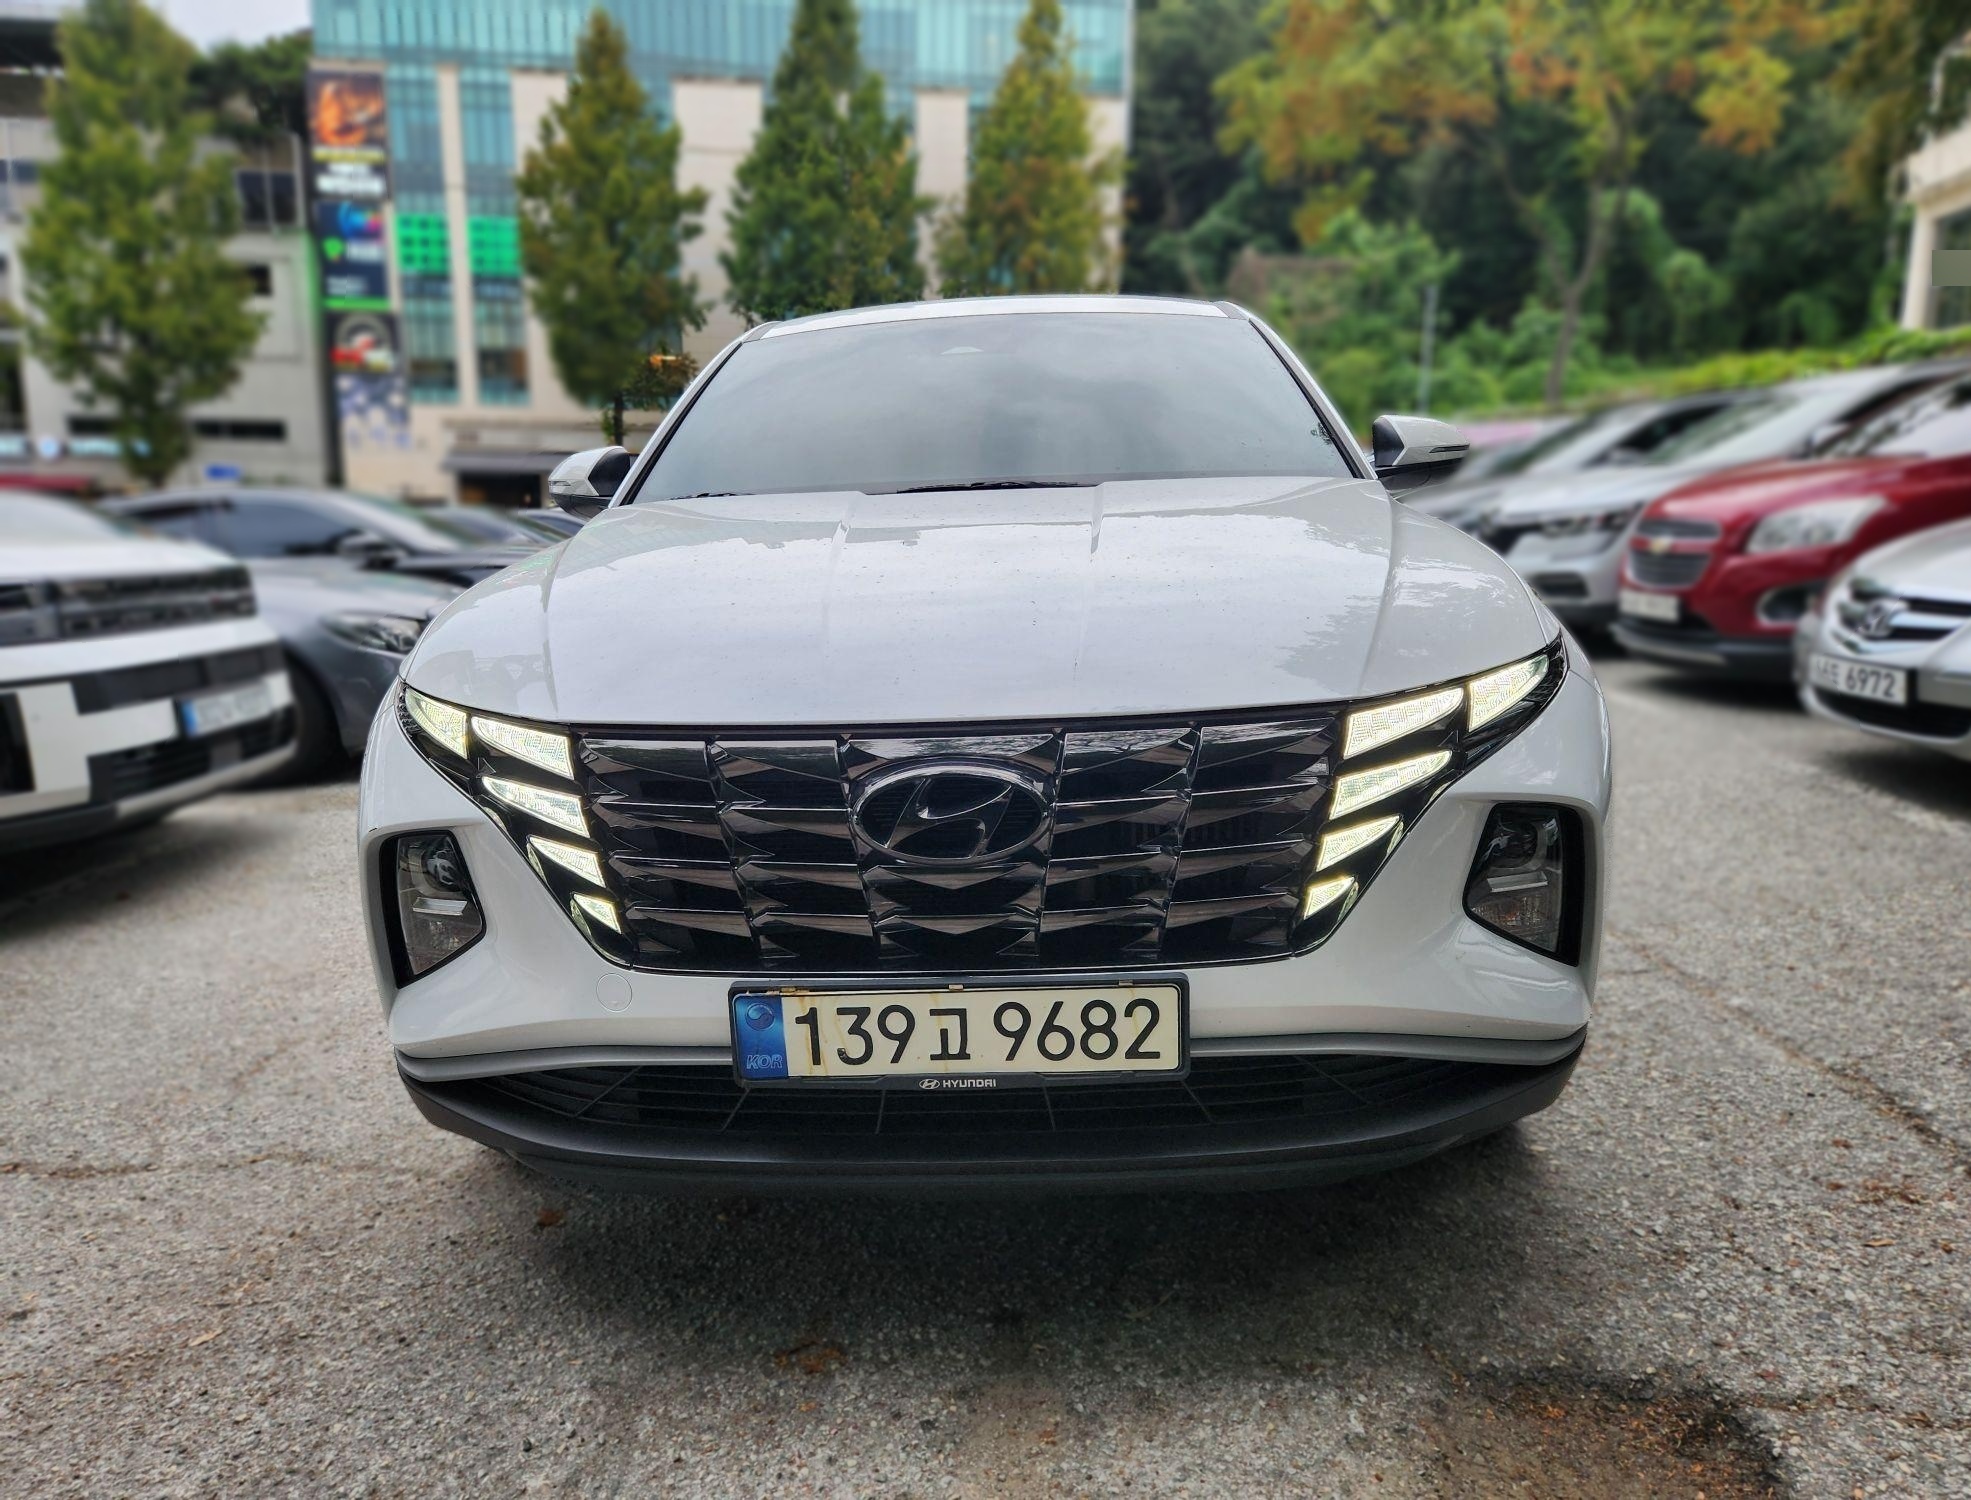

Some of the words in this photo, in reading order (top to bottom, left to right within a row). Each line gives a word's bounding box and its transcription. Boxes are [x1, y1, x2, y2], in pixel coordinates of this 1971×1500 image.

[1845, 666, 1896, 698] 6972
[993, 998, 1160, 1061] 9682
[746, 1054, 783, 1070] KOR
[942, 1079, 997, 1089] HYUNDAI
